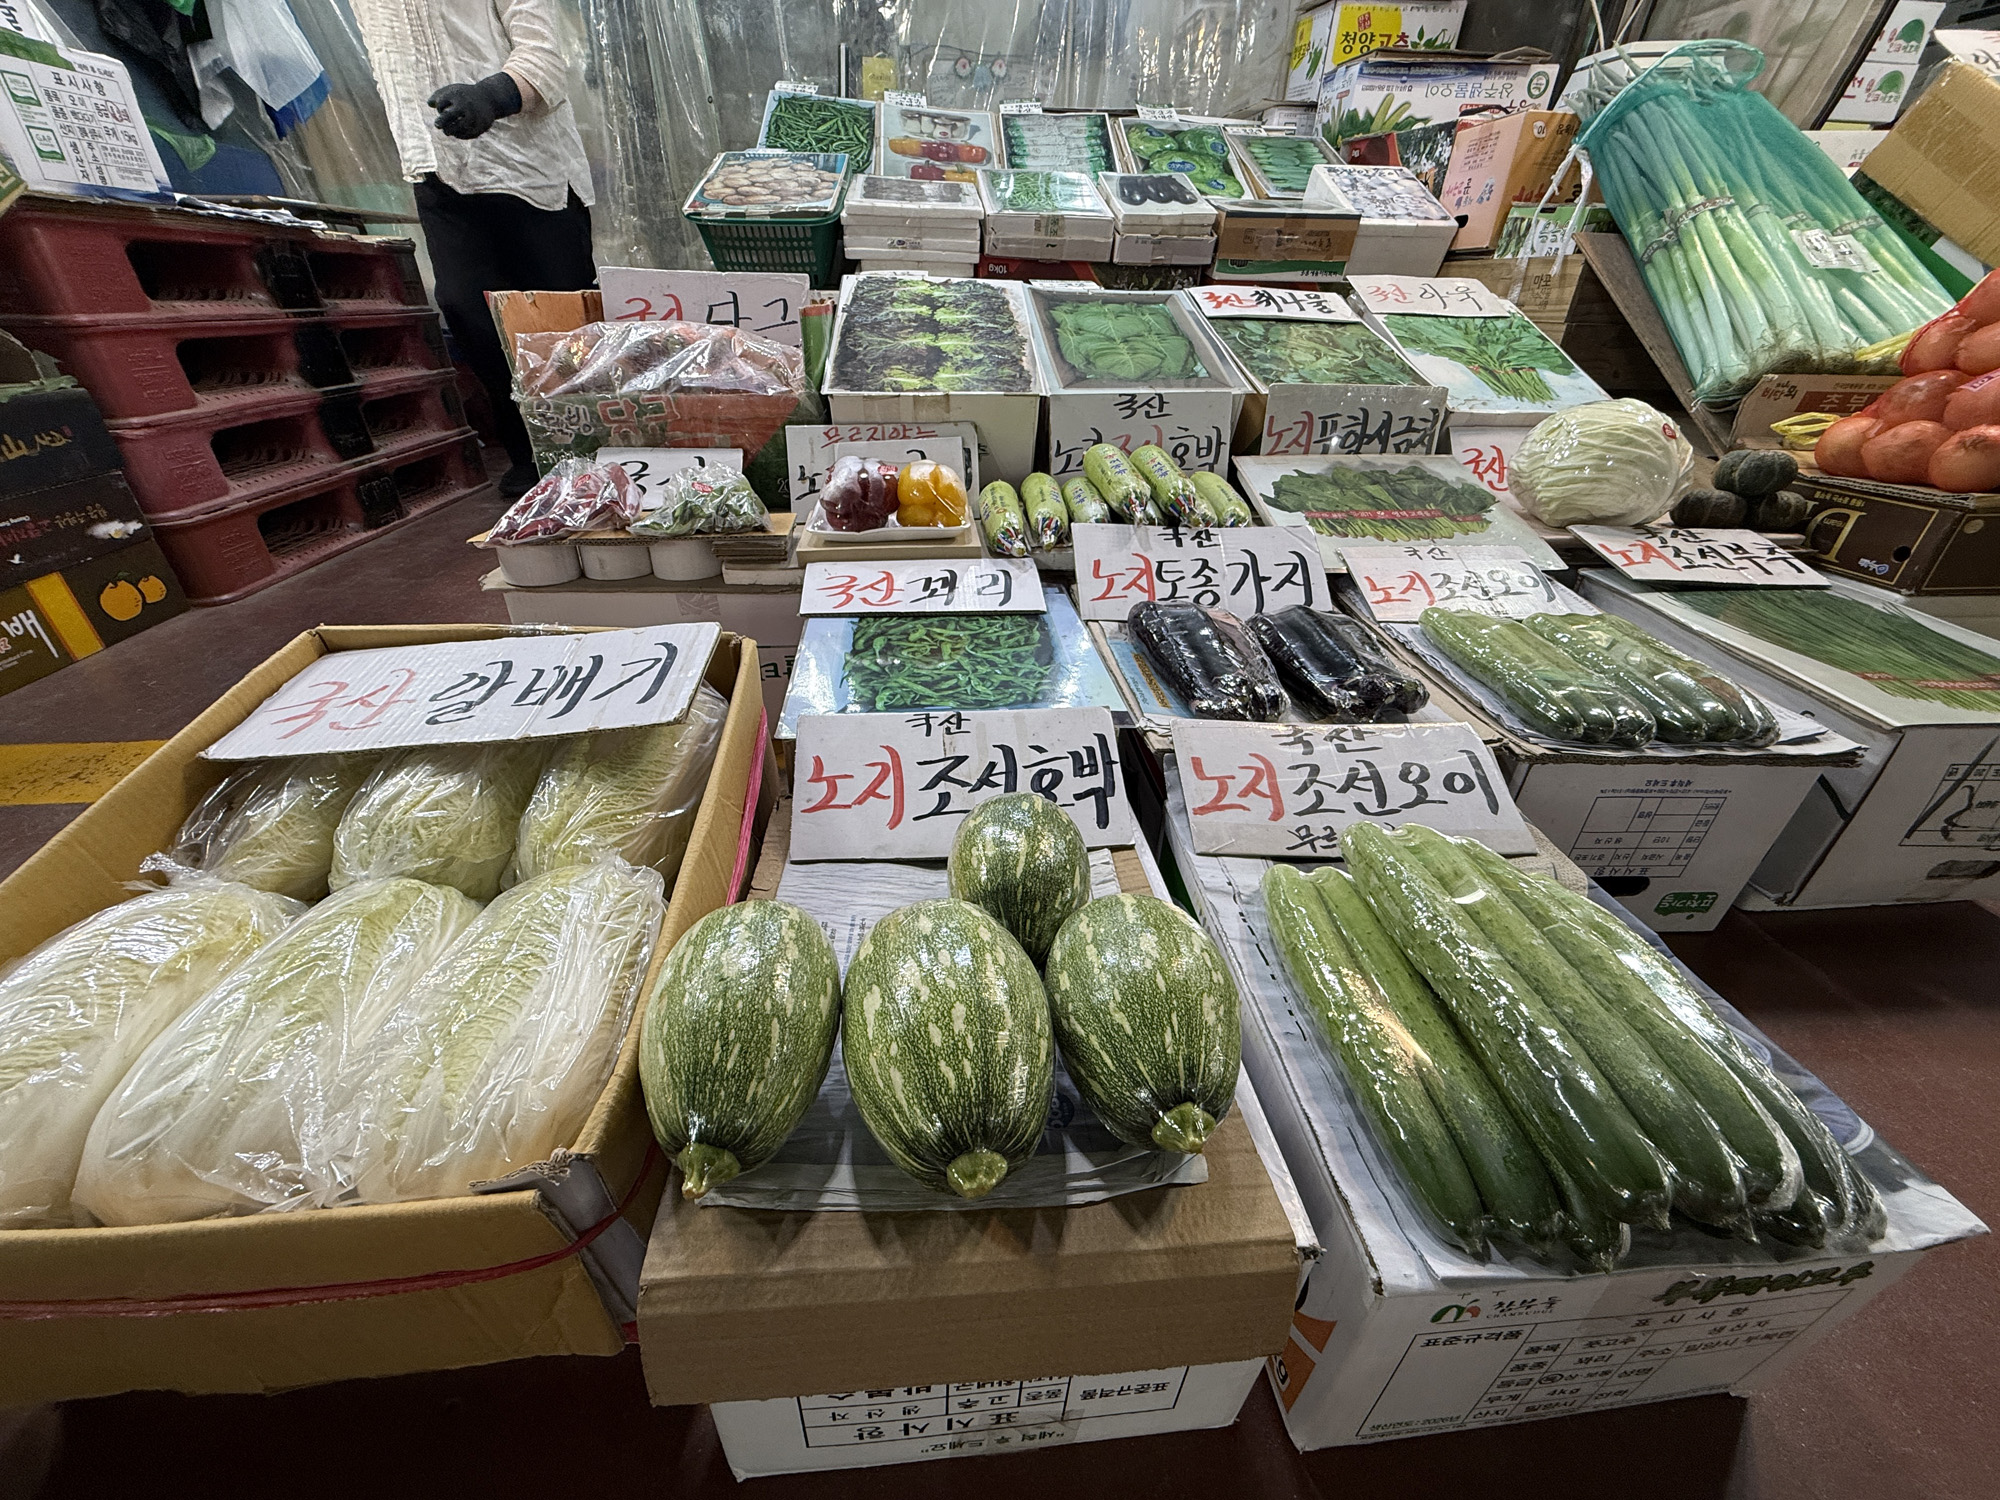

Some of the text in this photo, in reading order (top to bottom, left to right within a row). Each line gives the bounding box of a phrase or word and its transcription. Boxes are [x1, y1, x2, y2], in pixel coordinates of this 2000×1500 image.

[51, 71, 106, 97] 표시사항
[35, 132, 53, 143] GAP
[987, 263, 1008, 274] 10kg
[1420, 283, 1482, 311] 아욱
[1113, 393, 1173, 419] 국산
[1169, 426, 1226, 472] 호박
[1157, 528, 1221, 548] 국산
[1404, 546, 1454, 561] 국산
[816, 571, 905, 609] 국산
[1364, 570, 1436, 606] 노지
[264, 668, 416, 740] 국산
[905, 711, 971, 737] 국산
[1271, 724, 1383, 756] 국산
[801, 745, 904, 830] 노지
[1190, 750, 1499, 821] 노지 조선오이
[1631, 1306, 1749, 1328] 표시사항
[1707, 1319, 1771, 1335] 생산자
[1420, 1329, 1526, 1348] 표준규격품
[957, 1394, 1010, 1409] 고추
[1081, 1381, 1171, 1400] 표준규격품
[1546, 1387, 1581, 1398] 4kg
[828, 1405, 921, 1422] 생산자
[853, 1411, 1018, 1440] 표시사항
[1472, 1408, 1508, 1420] 산지
